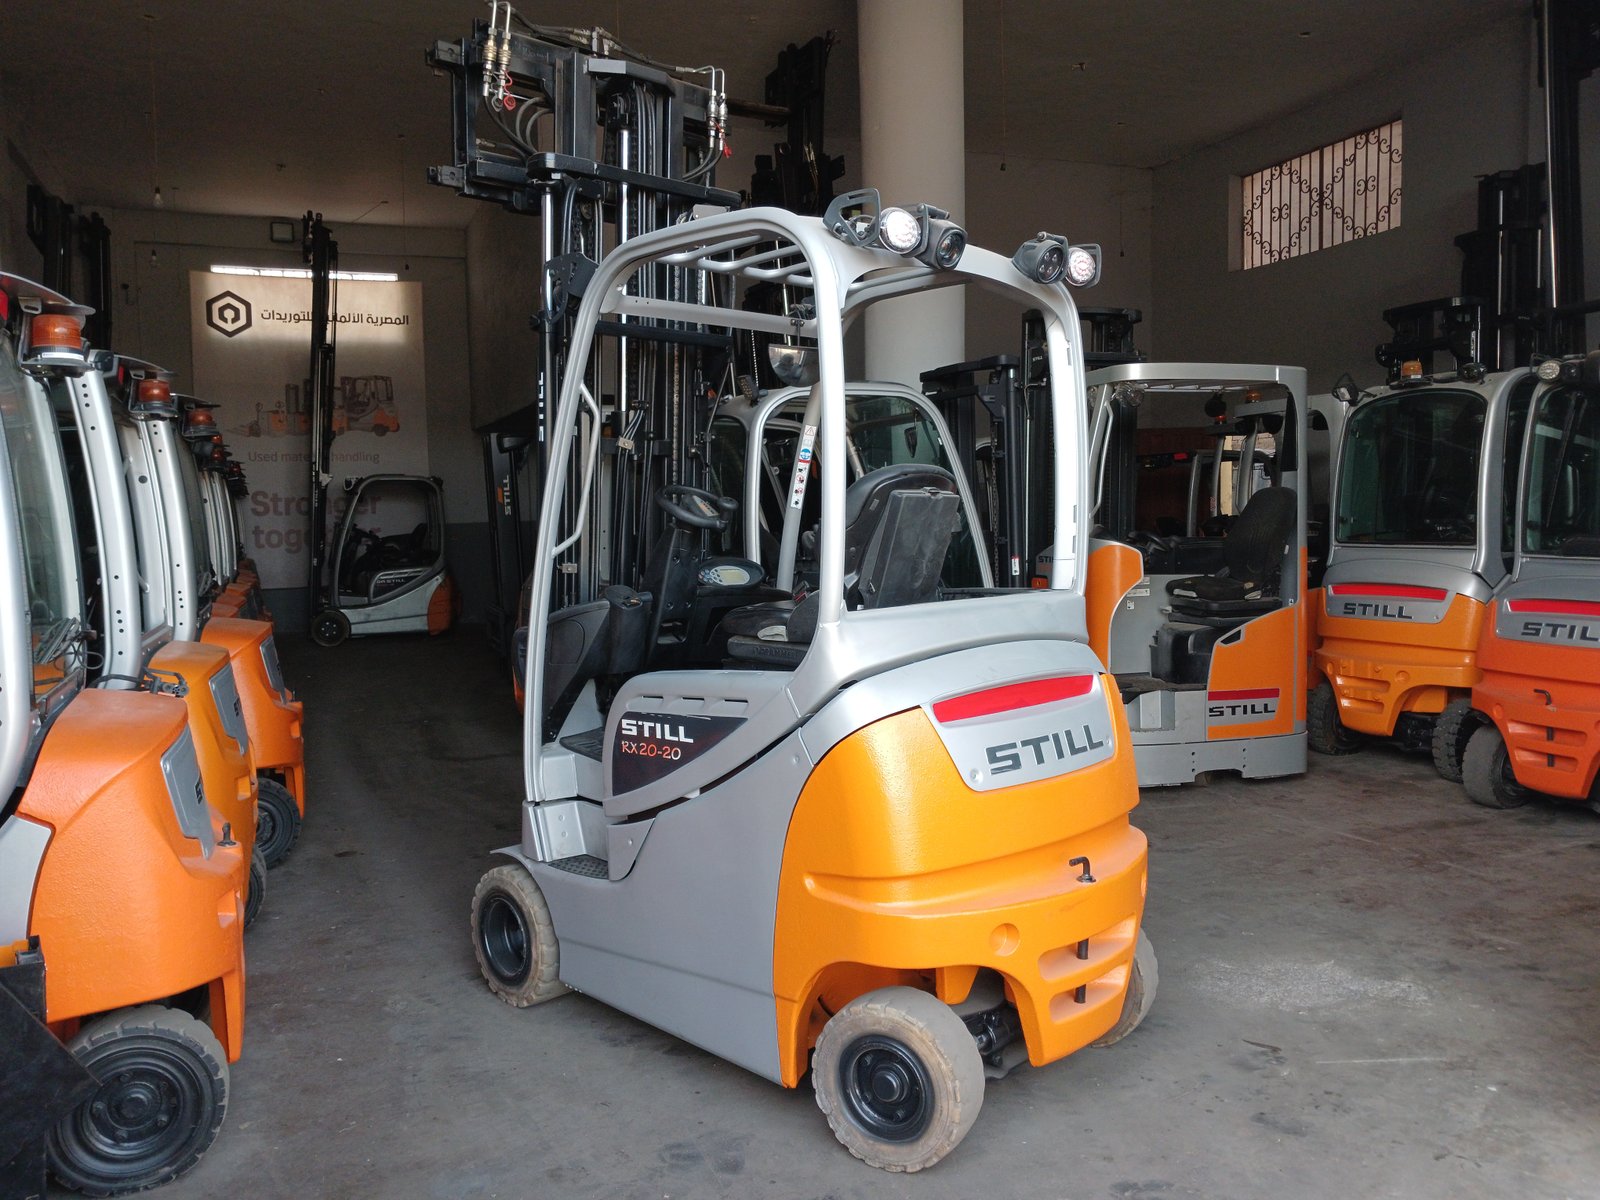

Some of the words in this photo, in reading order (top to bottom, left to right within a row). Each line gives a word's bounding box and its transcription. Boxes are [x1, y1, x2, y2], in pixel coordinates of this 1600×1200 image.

[366, 312, 409, 327] المصرية
[248, 451, 278, 463] Used
[331, 451, 380, 465] handling
[503, 474, 512, 516] STILL
[1038, 555, 1054, 563] STI
[1343, 602, 1413, 620] STILL
[1521, 622, 1600, 642] STIL
[1208, 703, 1276, 718] STILL
[621, 718, 694, 744] STILL
[985, 724, 1104, 776] STILL
